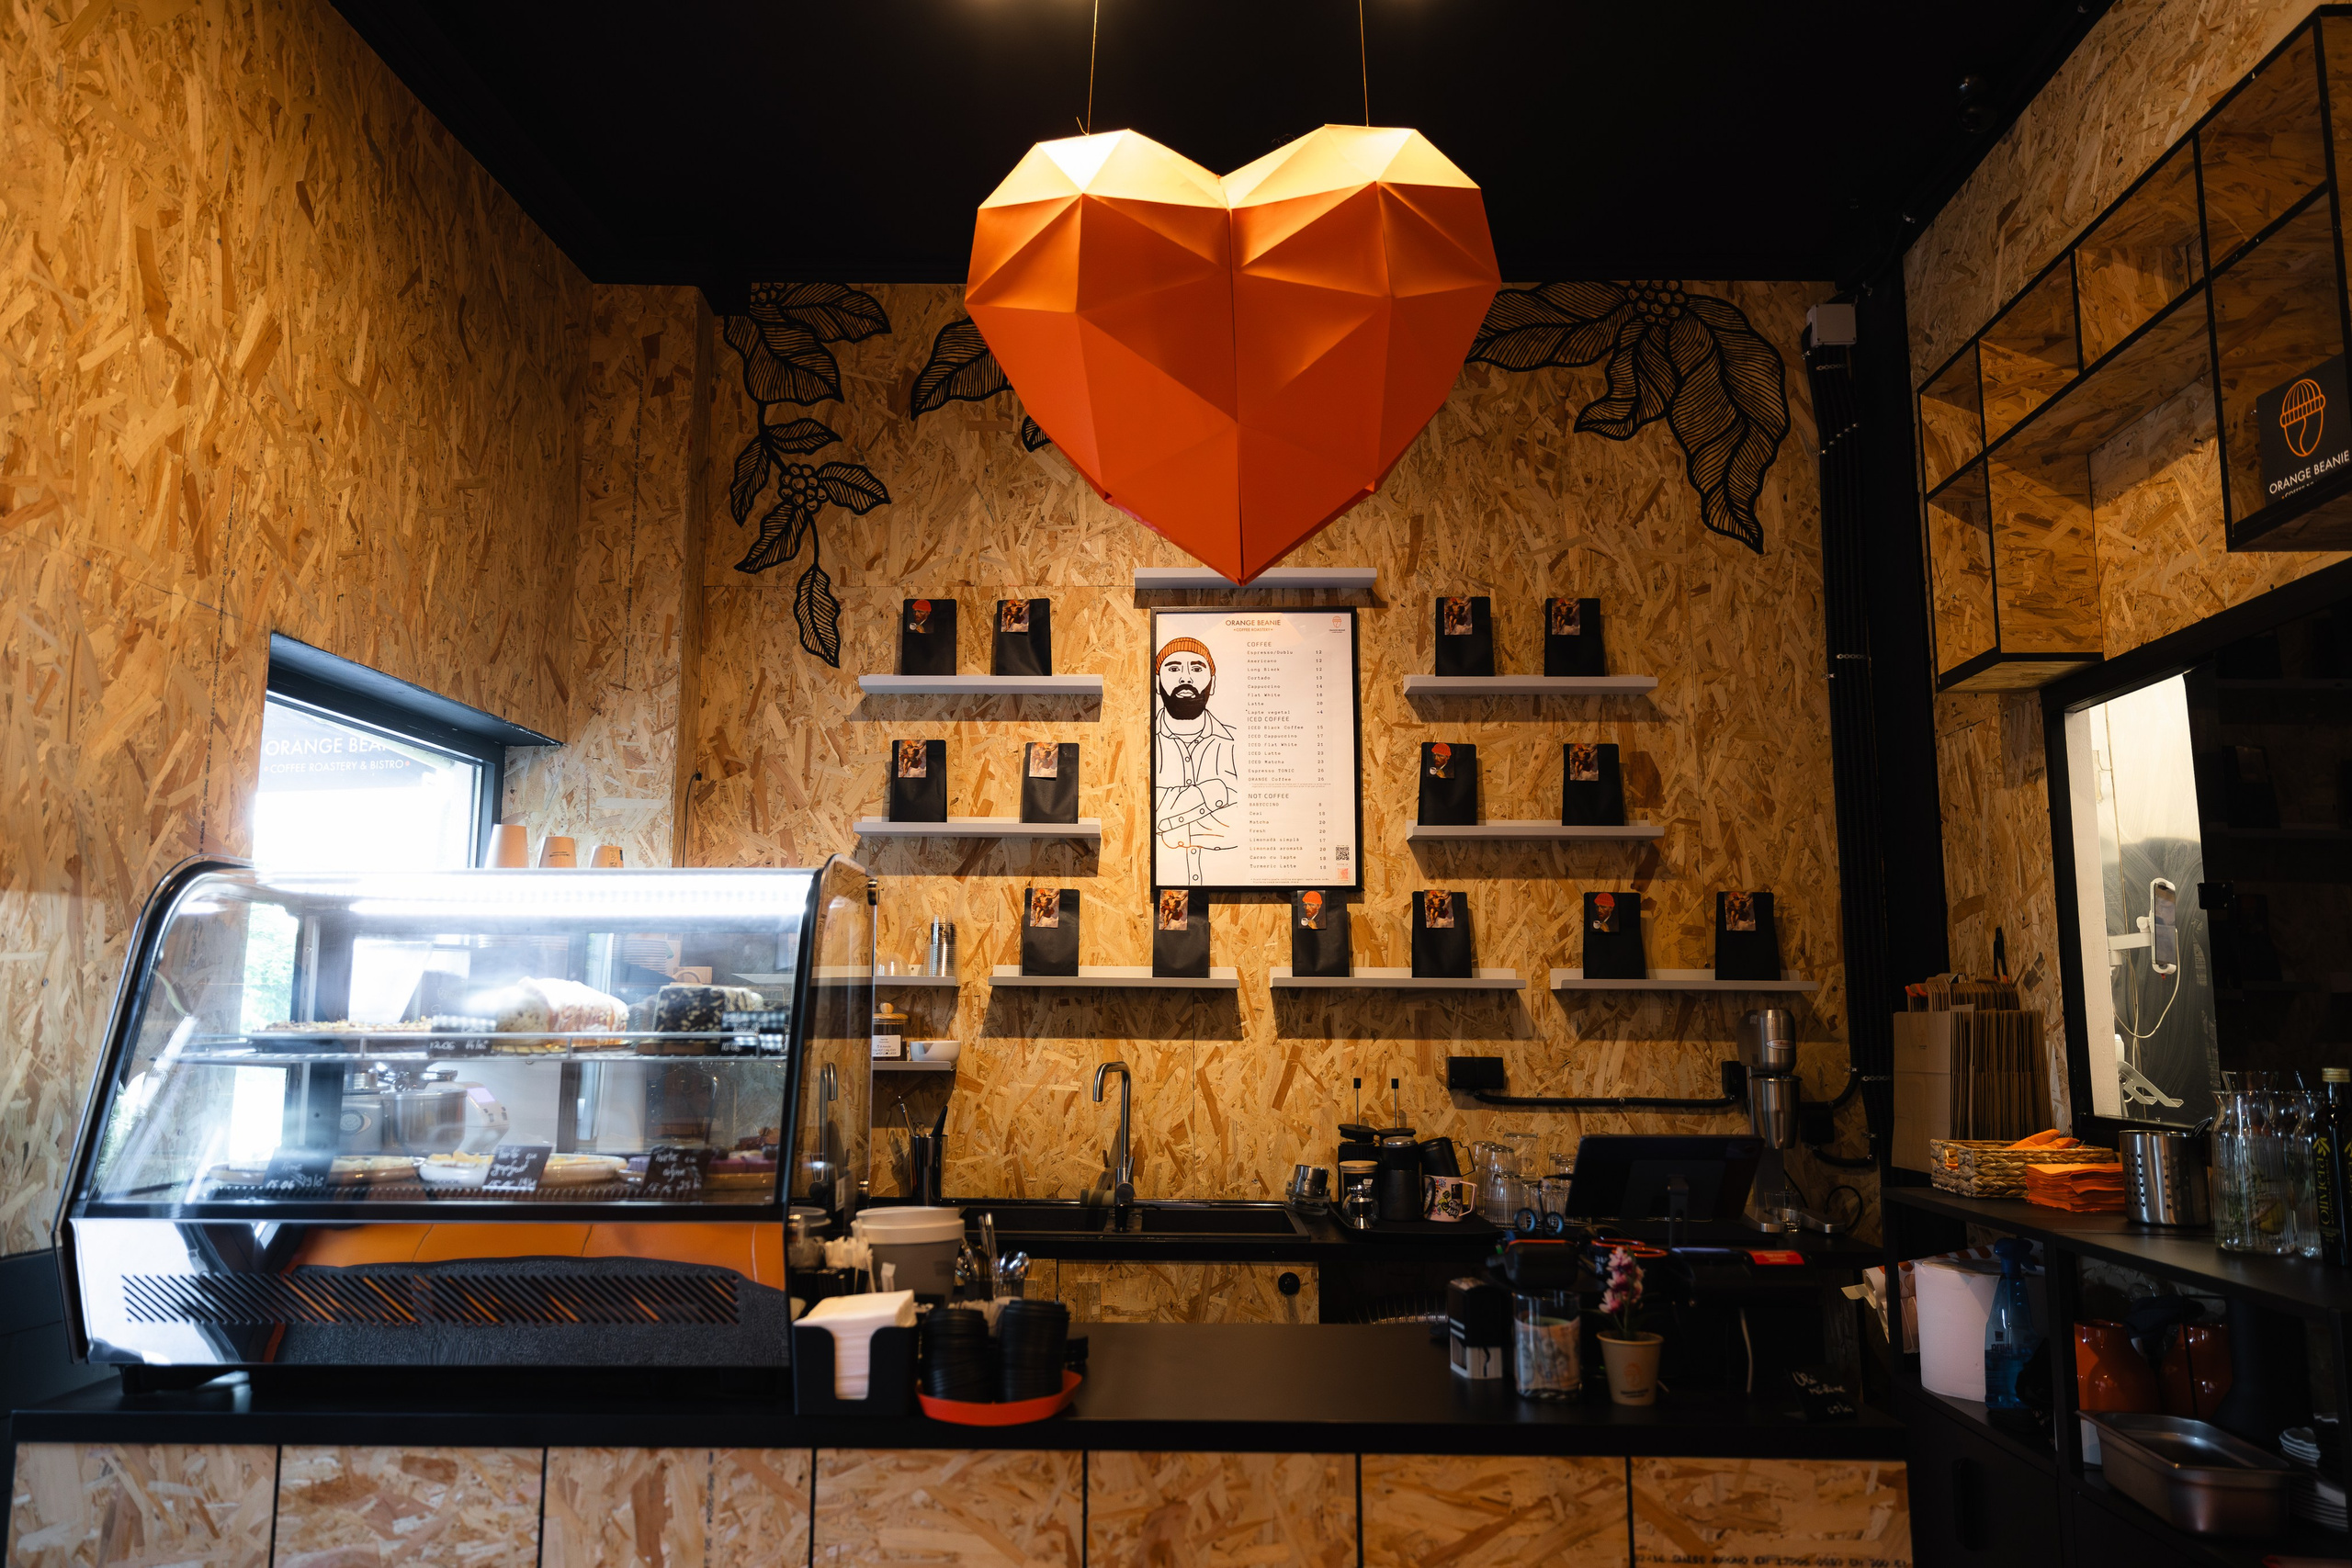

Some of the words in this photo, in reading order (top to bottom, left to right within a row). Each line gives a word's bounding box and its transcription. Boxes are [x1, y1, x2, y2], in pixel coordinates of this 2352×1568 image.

[2269, 467, 2311, 494] ORANGE
[2314, 450, 2350, 475] BEANIE
[265, 738, 342, 756] ORANGE
[270, 763, 306, 773] COFFEE
[309, 761, 356, 772] ROASTERY
[360, 761, 367, 770] &
[370, 760, 404, 769] BISTRO
